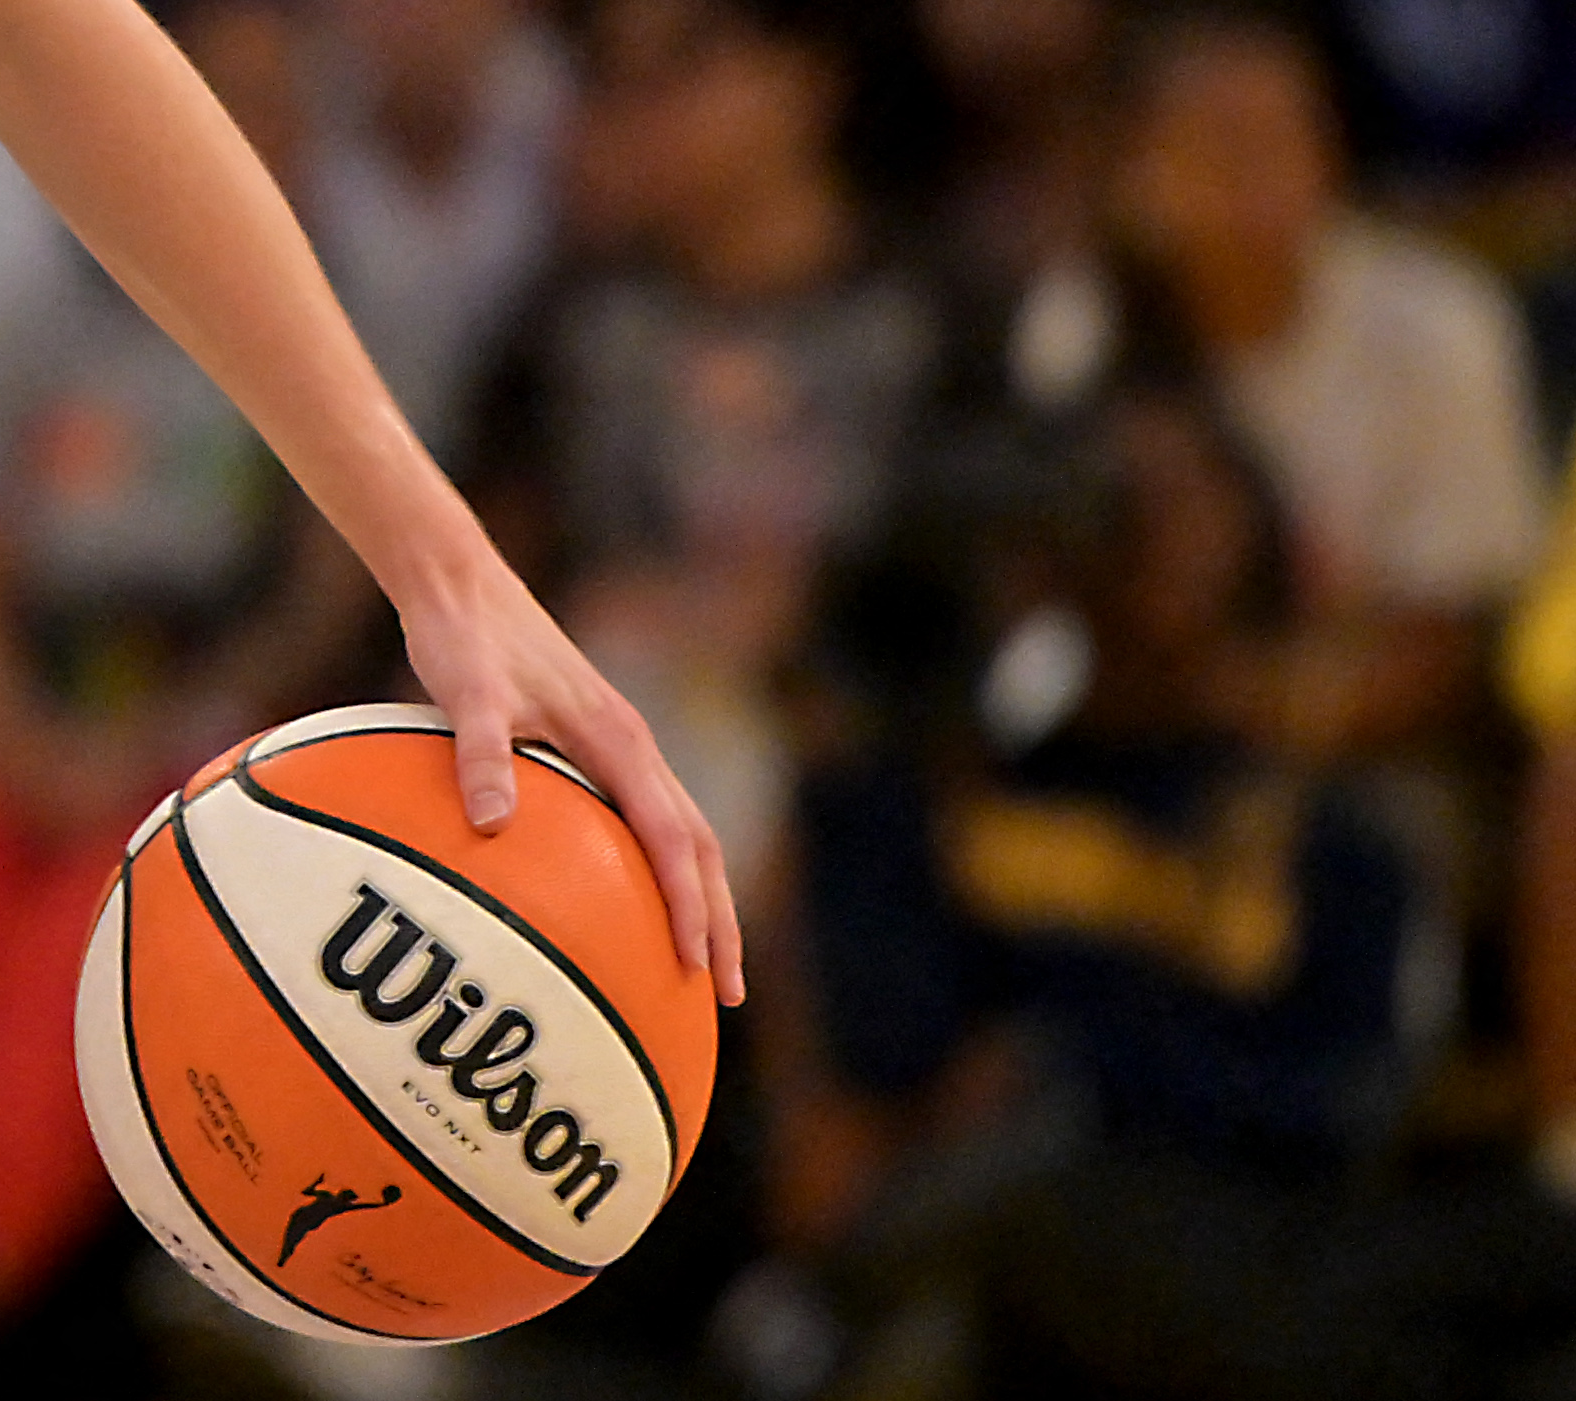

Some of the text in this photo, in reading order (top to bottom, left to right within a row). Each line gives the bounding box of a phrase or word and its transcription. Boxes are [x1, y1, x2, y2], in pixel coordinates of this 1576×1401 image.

[317, 878, 623, 1228] Wilson
[400, 1080, 483, 1155] EVO NXT
